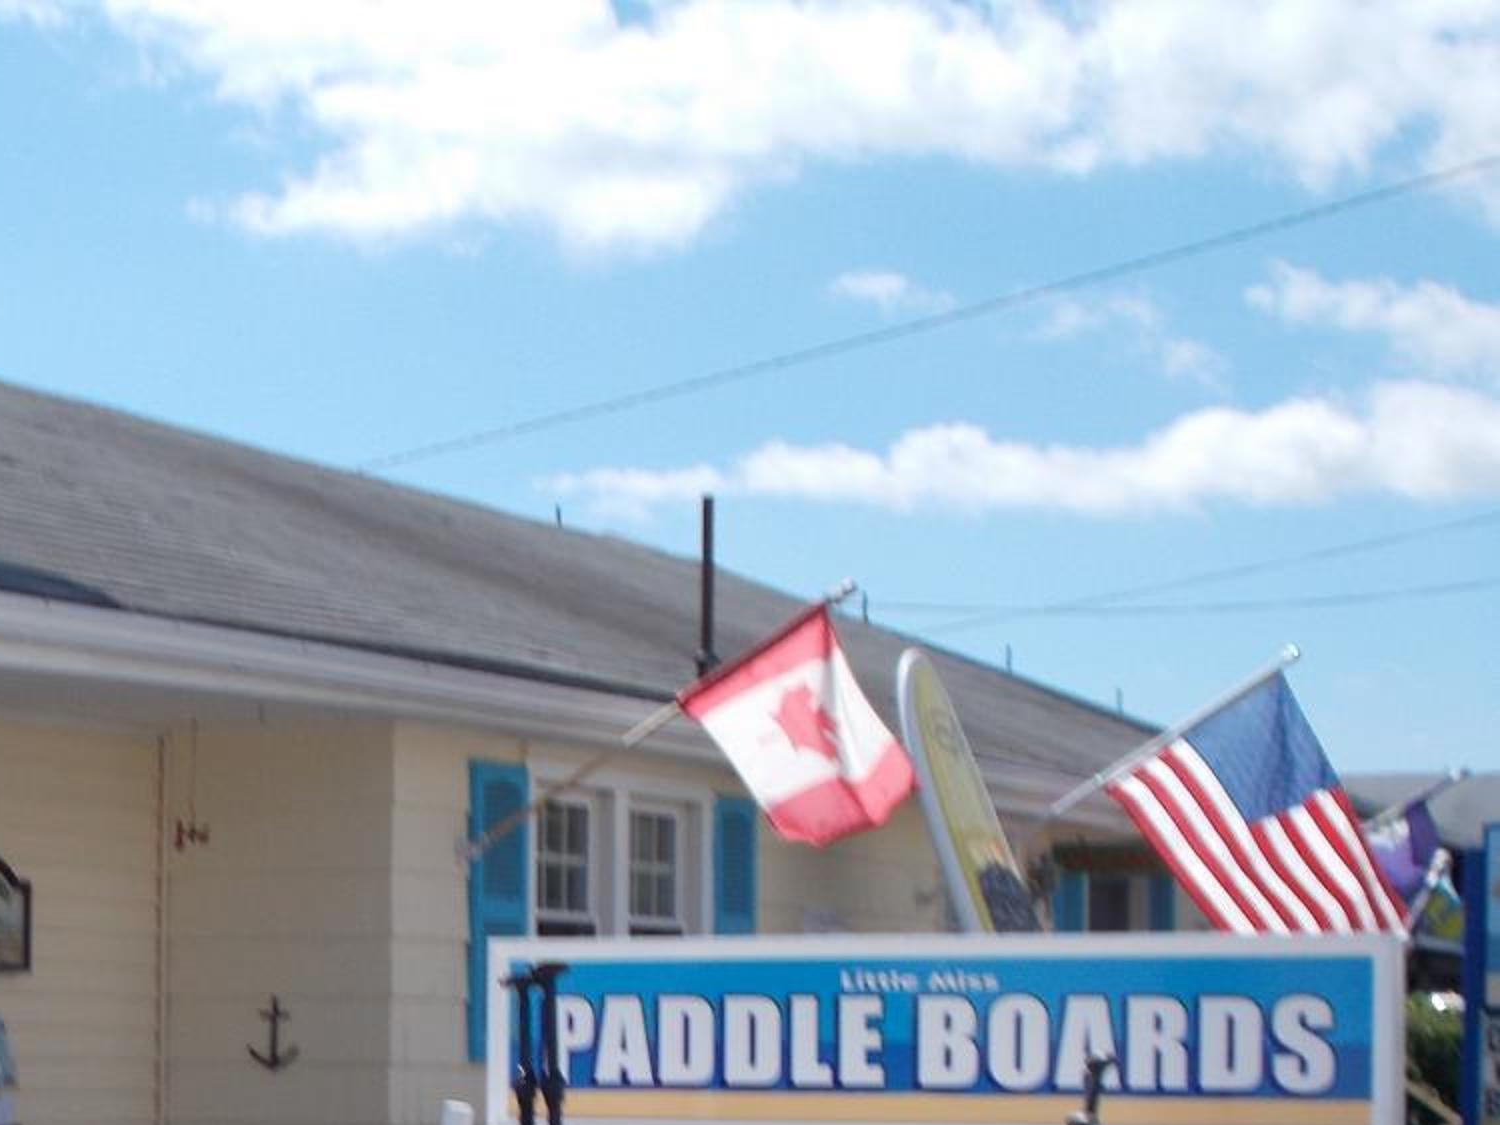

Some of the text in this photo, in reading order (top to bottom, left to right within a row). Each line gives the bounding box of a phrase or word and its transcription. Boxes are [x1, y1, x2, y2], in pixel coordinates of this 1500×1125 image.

[840, 968, 999, 993] Little Miss
[554, 993, 1337, 1093] PADDLE BOARDS
